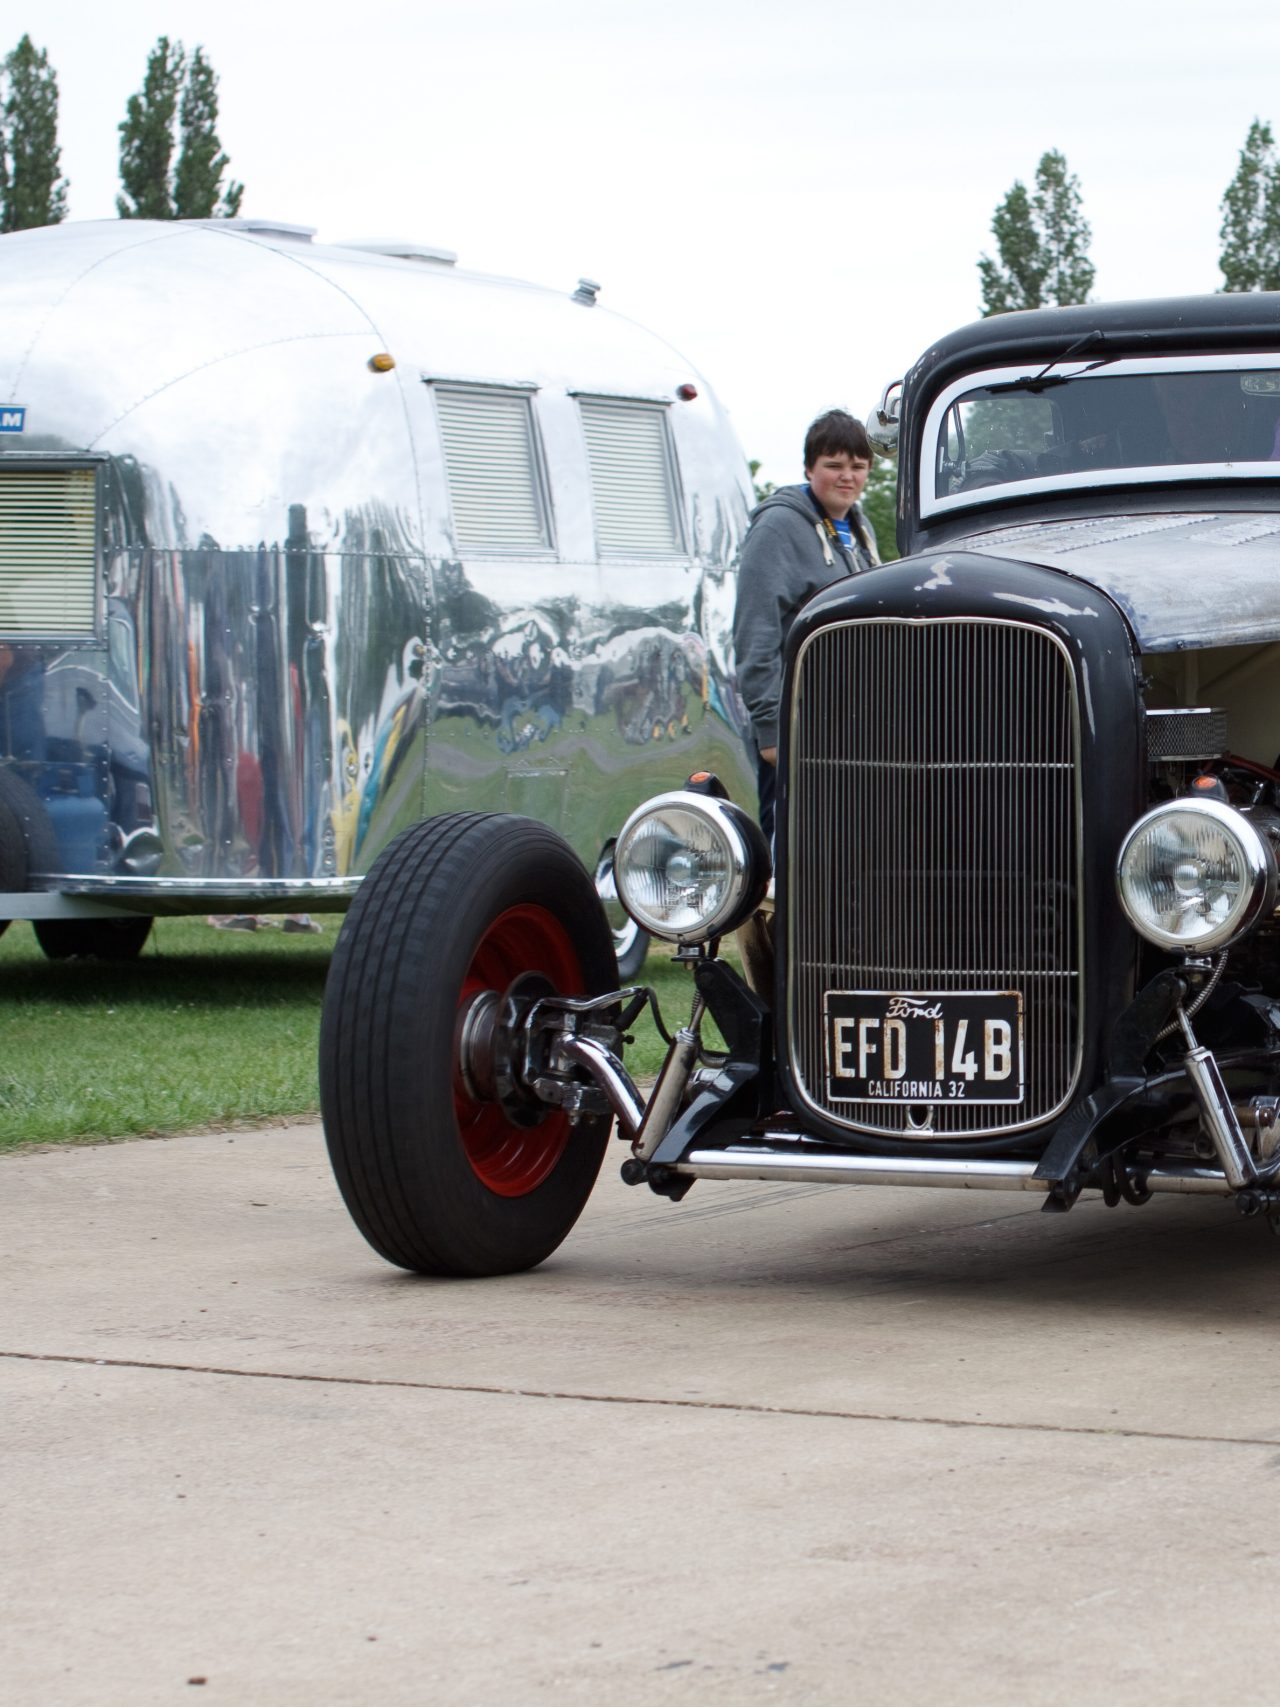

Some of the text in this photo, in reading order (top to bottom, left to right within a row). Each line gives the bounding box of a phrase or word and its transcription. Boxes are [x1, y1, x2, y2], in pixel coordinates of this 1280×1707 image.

[886, 997, 943, 1019] Ford
[834, 1017, 1012, 1081] EFD 14B
[868, 1079, 966, 1098] CALIFORNIA 32
